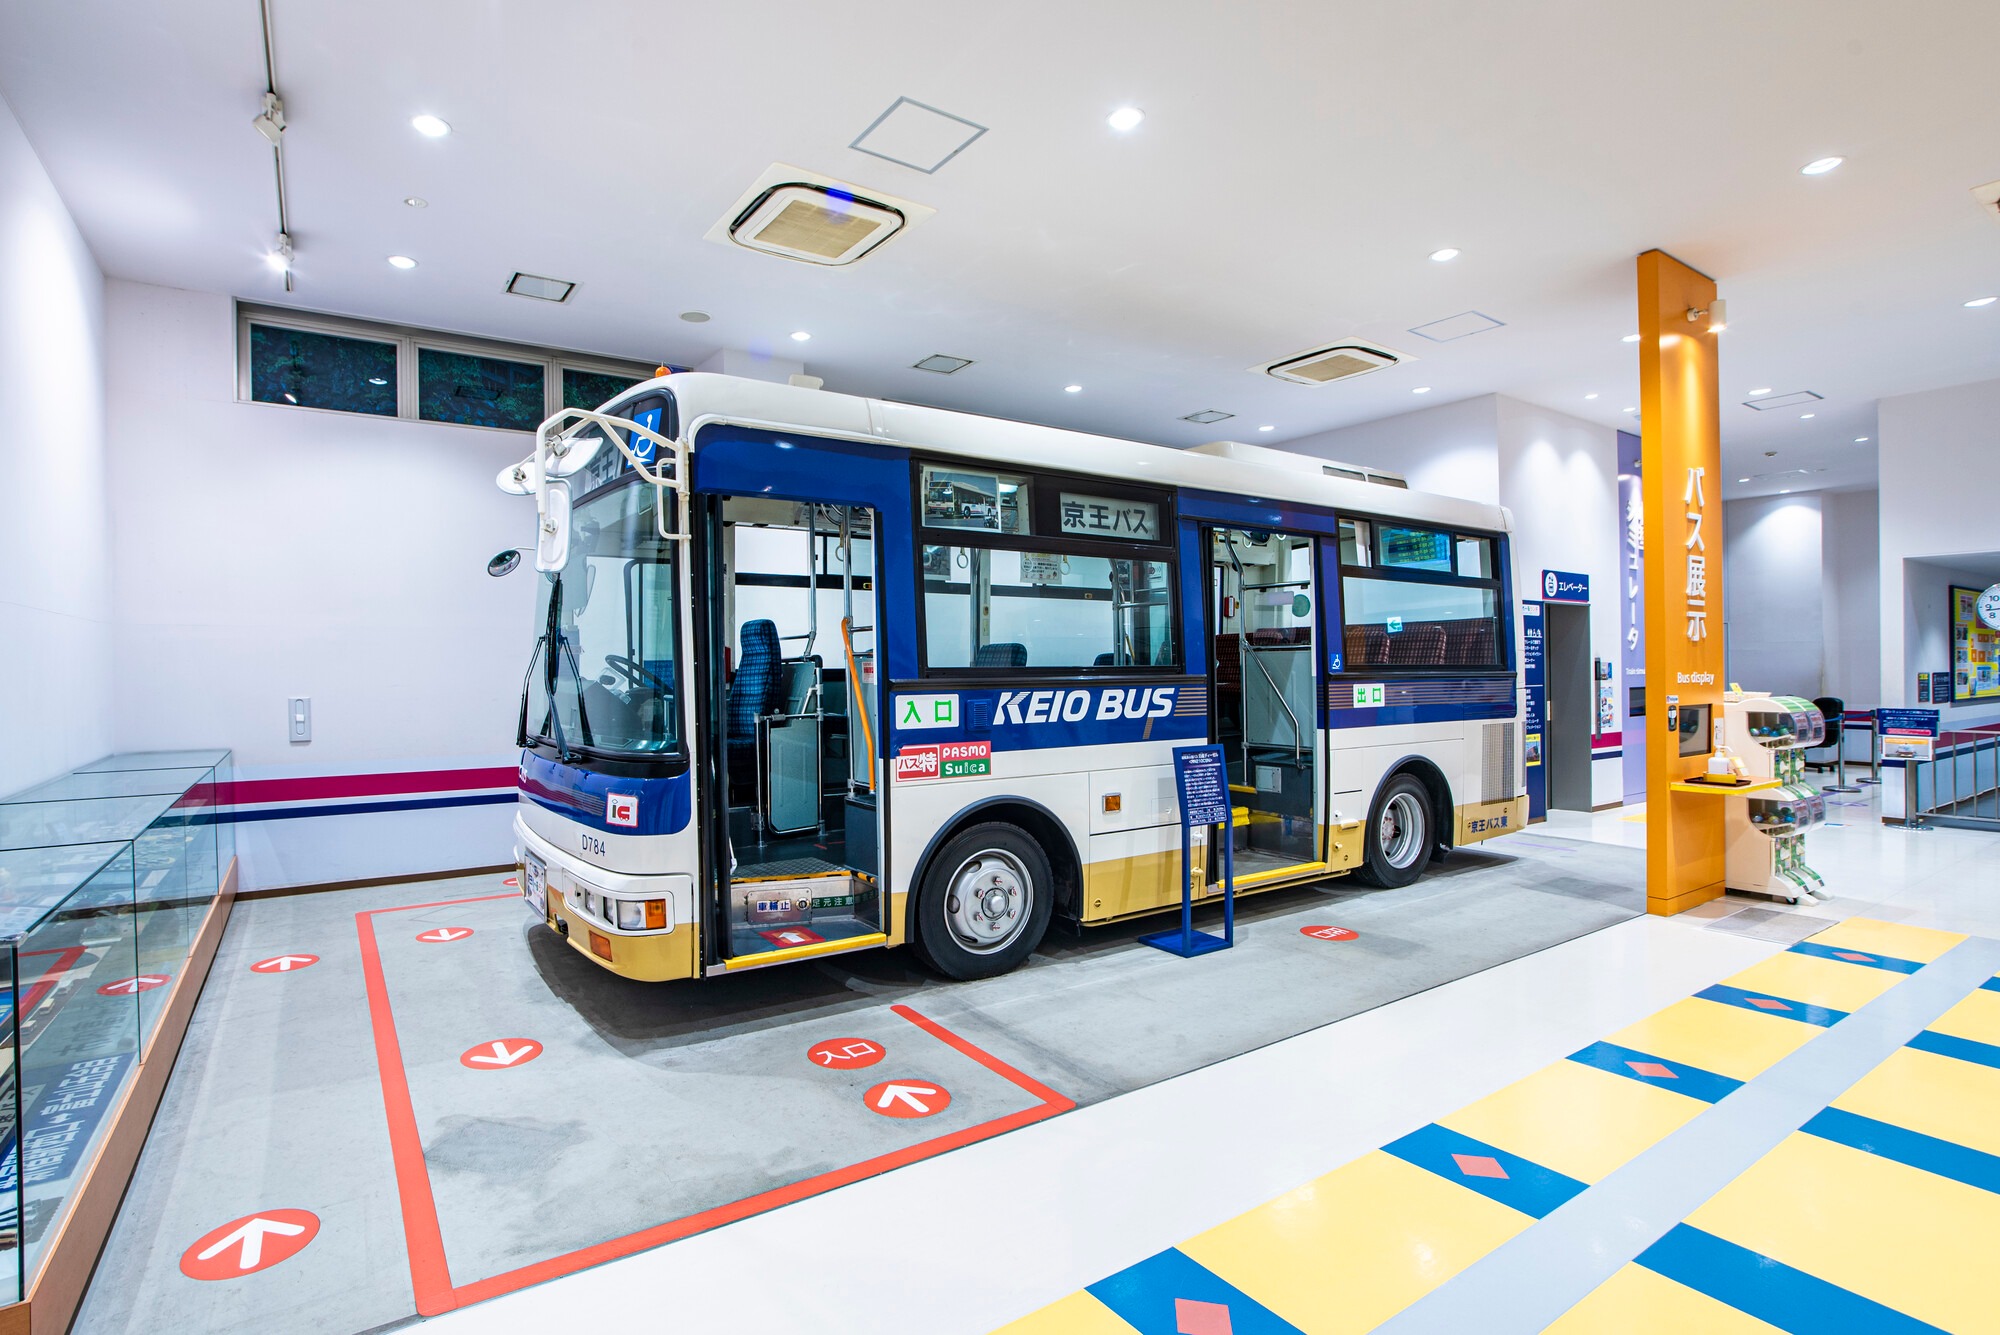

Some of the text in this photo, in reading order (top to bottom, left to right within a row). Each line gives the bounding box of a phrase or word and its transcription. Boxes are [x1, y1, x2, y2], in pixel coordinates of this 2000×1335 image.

[1062, 501, 1149, 534] 京王バス
[1685, 467, 1707, 642] バス展示
[1558, 581, 1588, 592] エレベーター
[1677, 671, 1714, 685] Bus display
[1357, 688, 1381, 703] 出口
[903, 700, 952, 723] 入口
[993, 688, 1175, 725] KEIO BUS
[943, 745, 986, 758] PASMO
[945, 762, 985, 774] Suica
[1471, 816, 1508, 833] 京王バス東
[582, 834, 606, 856] D784
[816, 1042, 877, 1064] 入口
